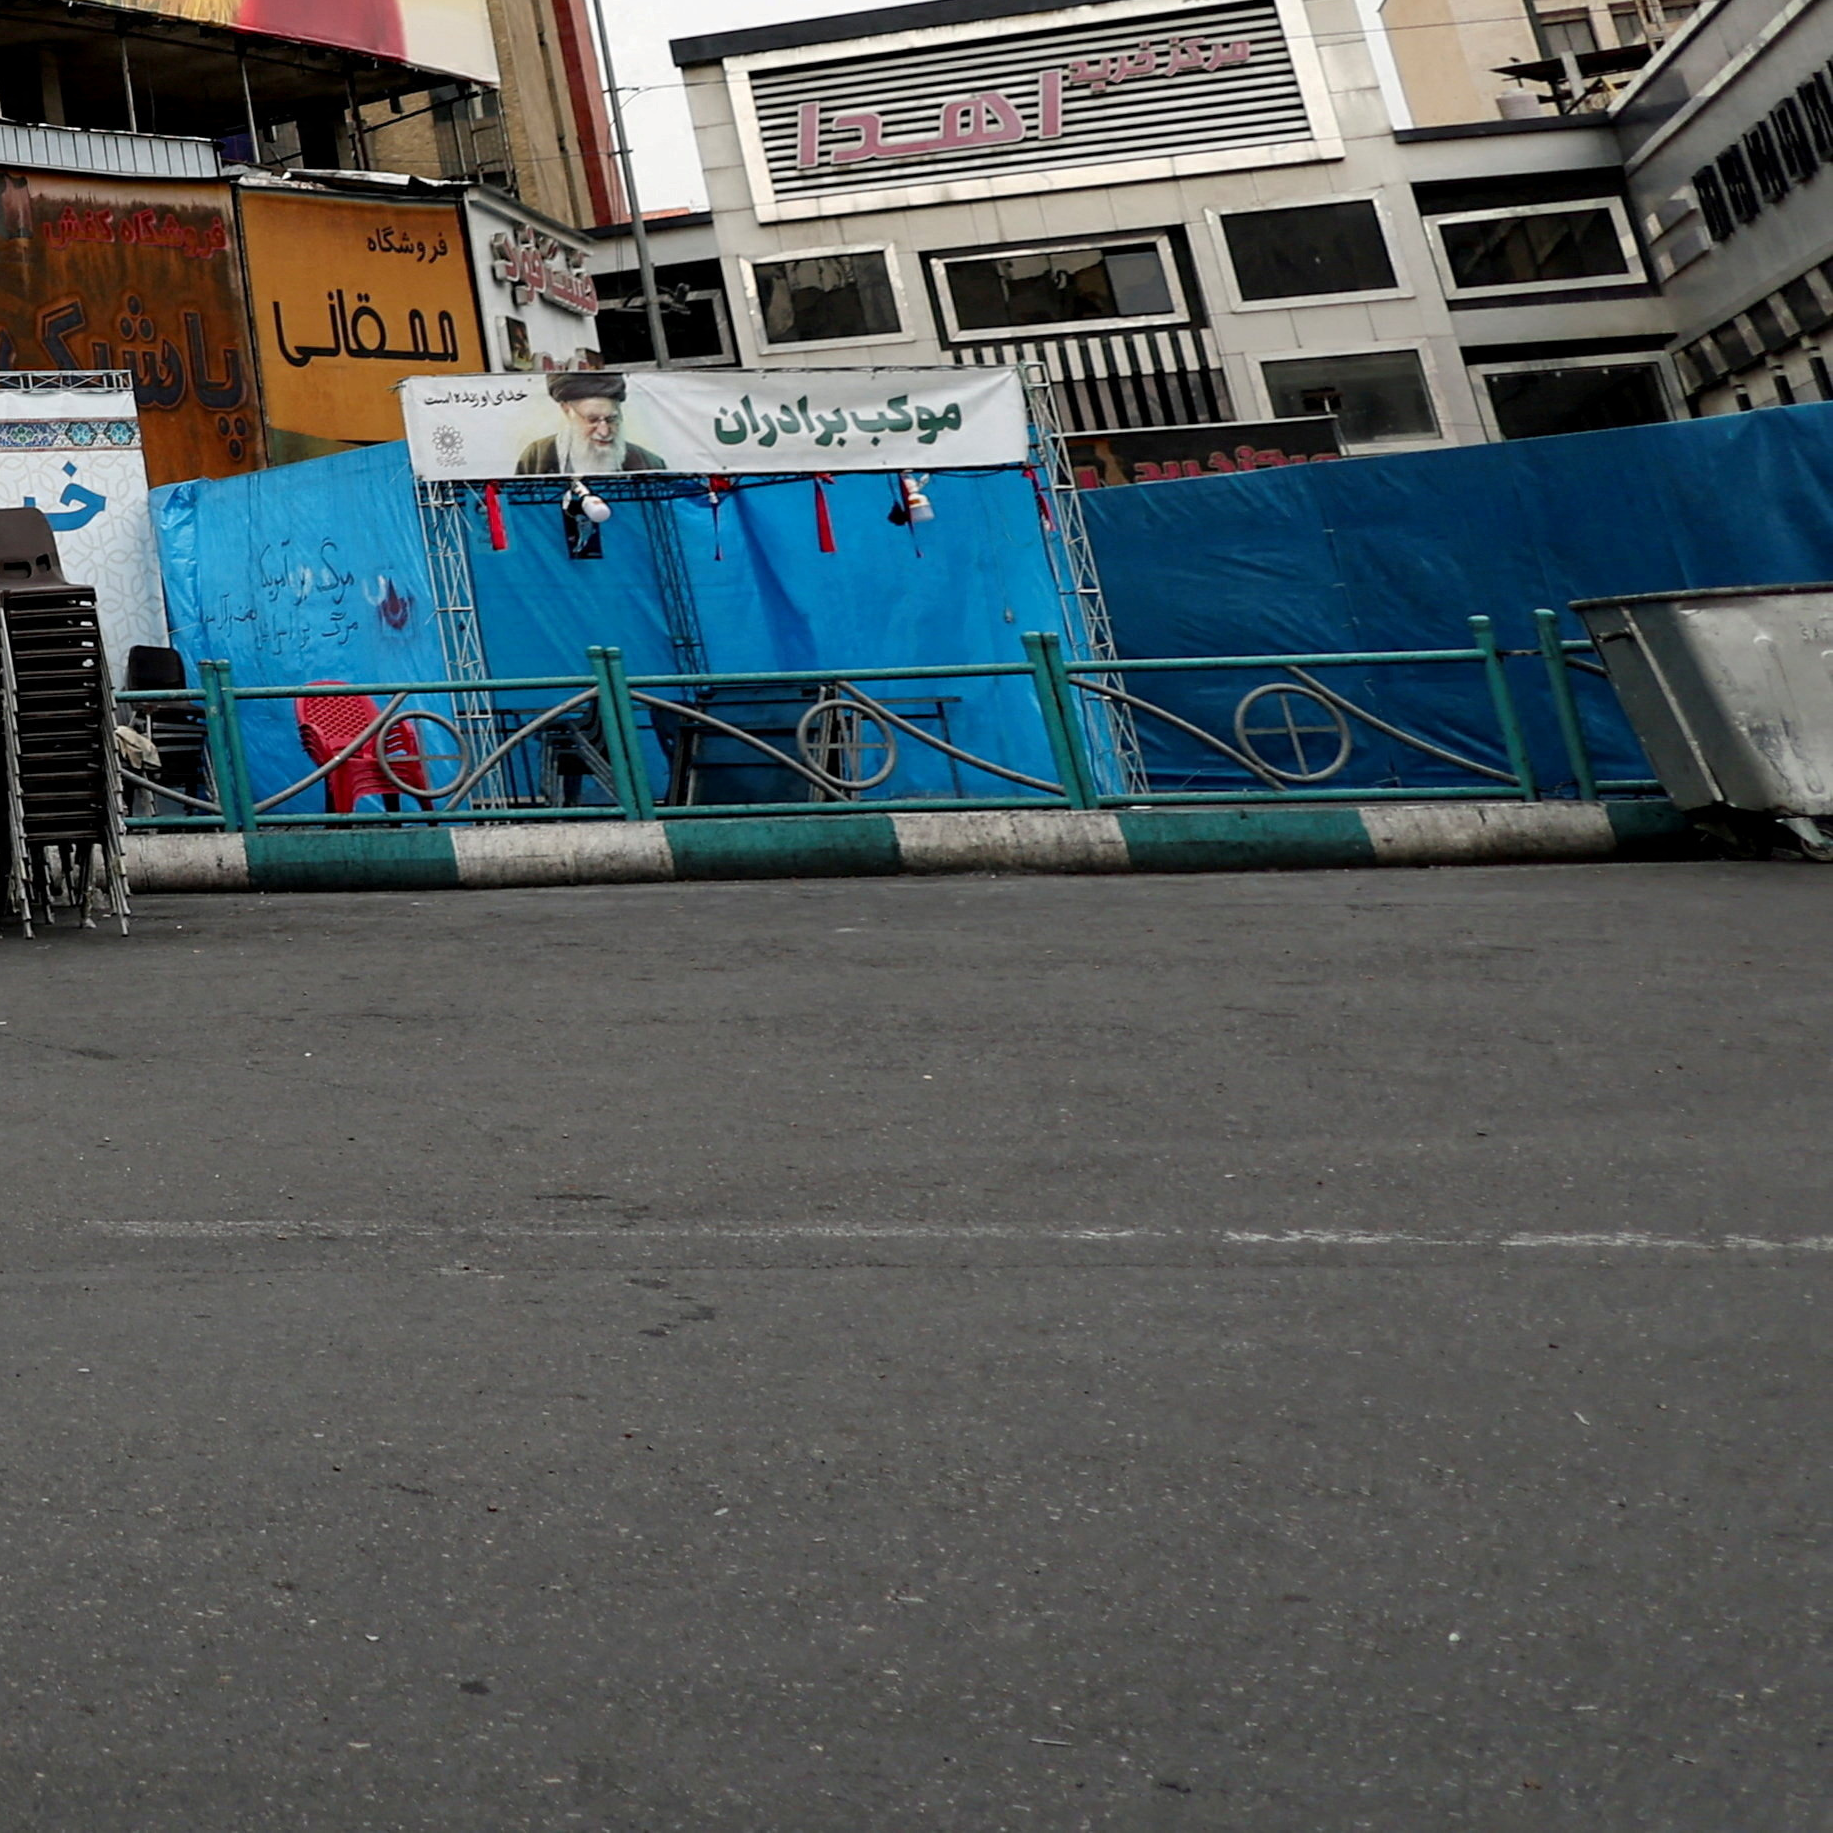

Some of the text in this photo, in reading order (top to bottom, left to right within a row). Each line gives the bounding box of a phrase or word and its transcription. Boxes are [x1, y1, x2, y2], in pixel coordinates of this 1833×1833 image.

[1068, 35, 1252, 94] مرکز خرید
[796, 66, 1064, 170] اهدا
[42, 205, 232, 260] فروشگاه کفش
[366, 225, 449, 263] فروشگاه
[713, 393, 963, 449] موکب برادران
